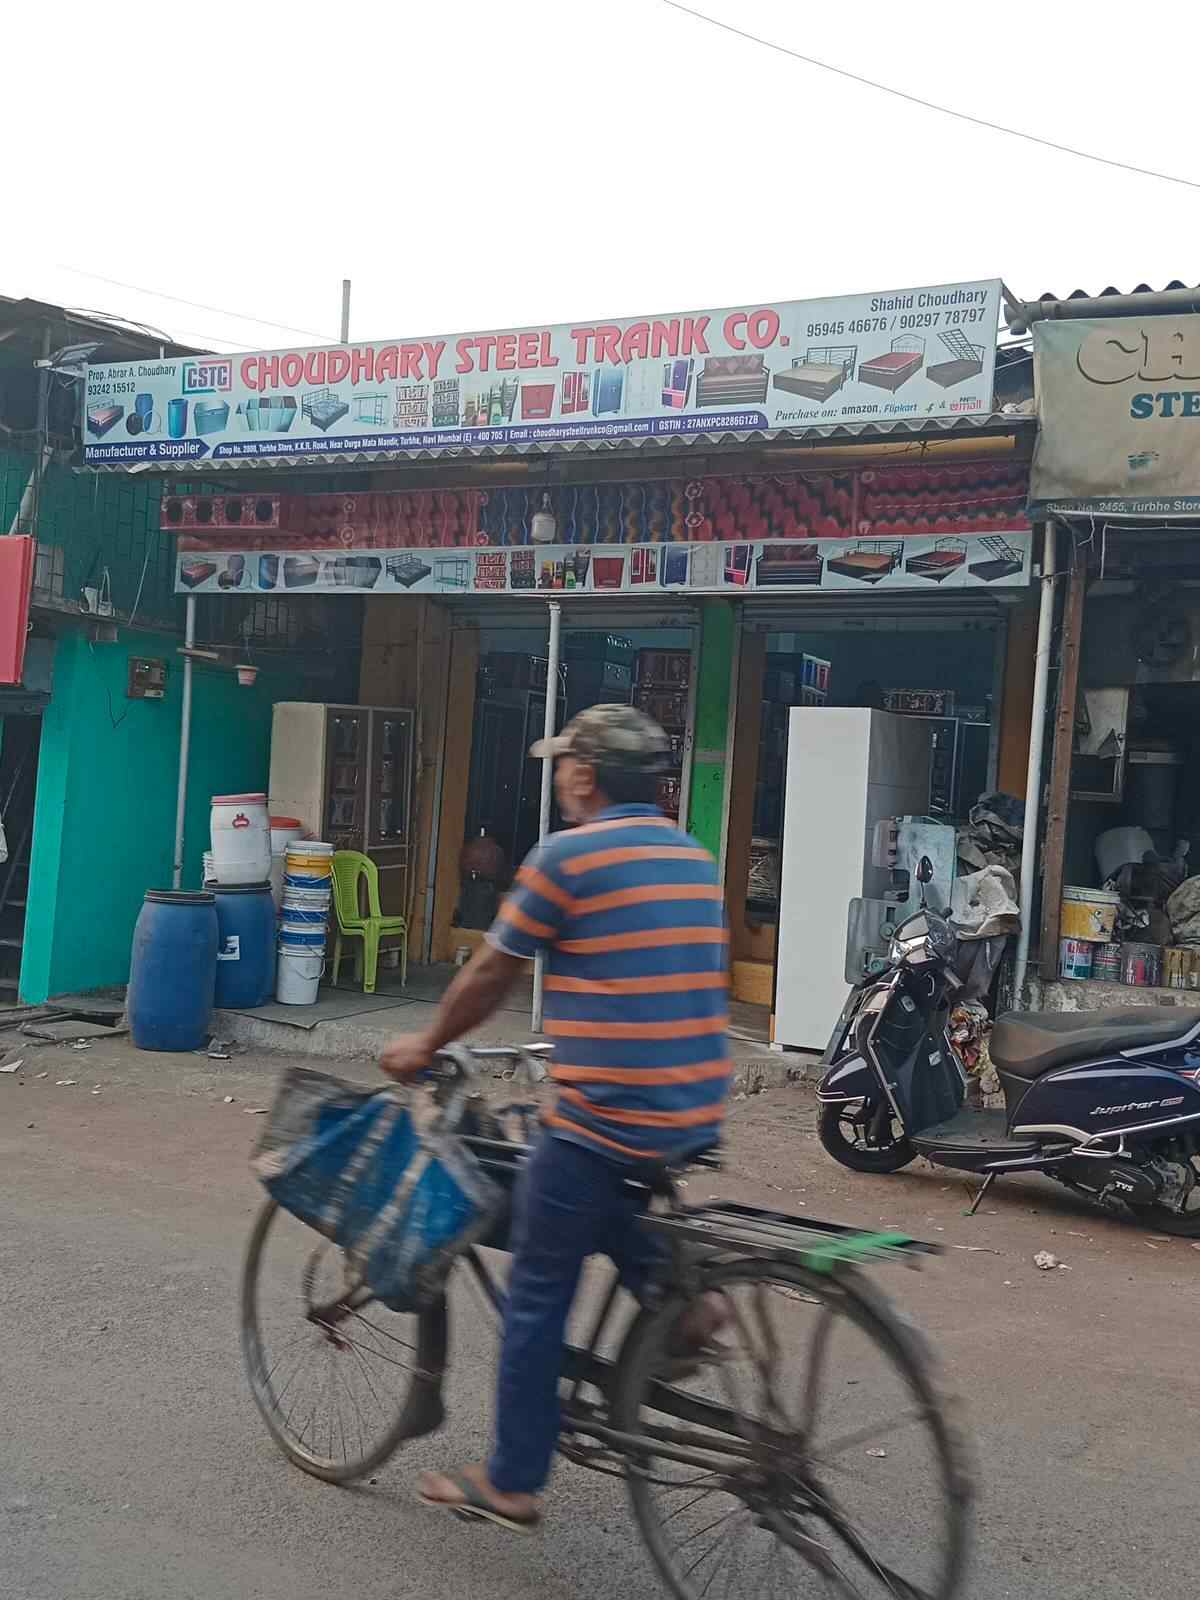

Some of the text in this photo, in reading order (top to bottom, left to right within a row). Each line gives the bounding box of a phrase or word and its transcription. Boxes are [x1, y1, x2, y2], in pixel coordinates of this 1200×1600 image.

[870, 290, 988, 312] Shahid Choudhary
[806, 321, 844, 337] 95945
[848, 317, 887, 333] 46676
[899, 312, 940, 329] 90297
[944, 308, 986, 324] 78797
[240, 309, 790, 393] CHOUDHARY STEEL TRANK CO.
[88, 365, 176, 381] Prop. Abrar A. Choudhary
[187, 366, 228, 388] CSTC
[87, 382, 136, 395] 93242 15512
[775, 406, 819, 420] Purchase
[884, 401, 918, 413] Flipkart
[329, 439, 343, 449] Near
[344, 438, 361, 449] Durga
[362, 437, 377, 448] Mata
[422, 434, 437, 445] Navi
[437, 432, 462, 444] Mumbai
[478, 431, 490, 441] 400
[491, 430, 503, 441] 705
[509, 428, 528, 439] Email
[658, 419, 681, 431] GSTIN
[85, 443, 201, 459] Manufacturer & Supplier
[1132, 501, 1170, 512] Turbhe
[1090, 1101, 1160, 1115] Jupiter
[1116, 1181, 1134, 1192] TVS
